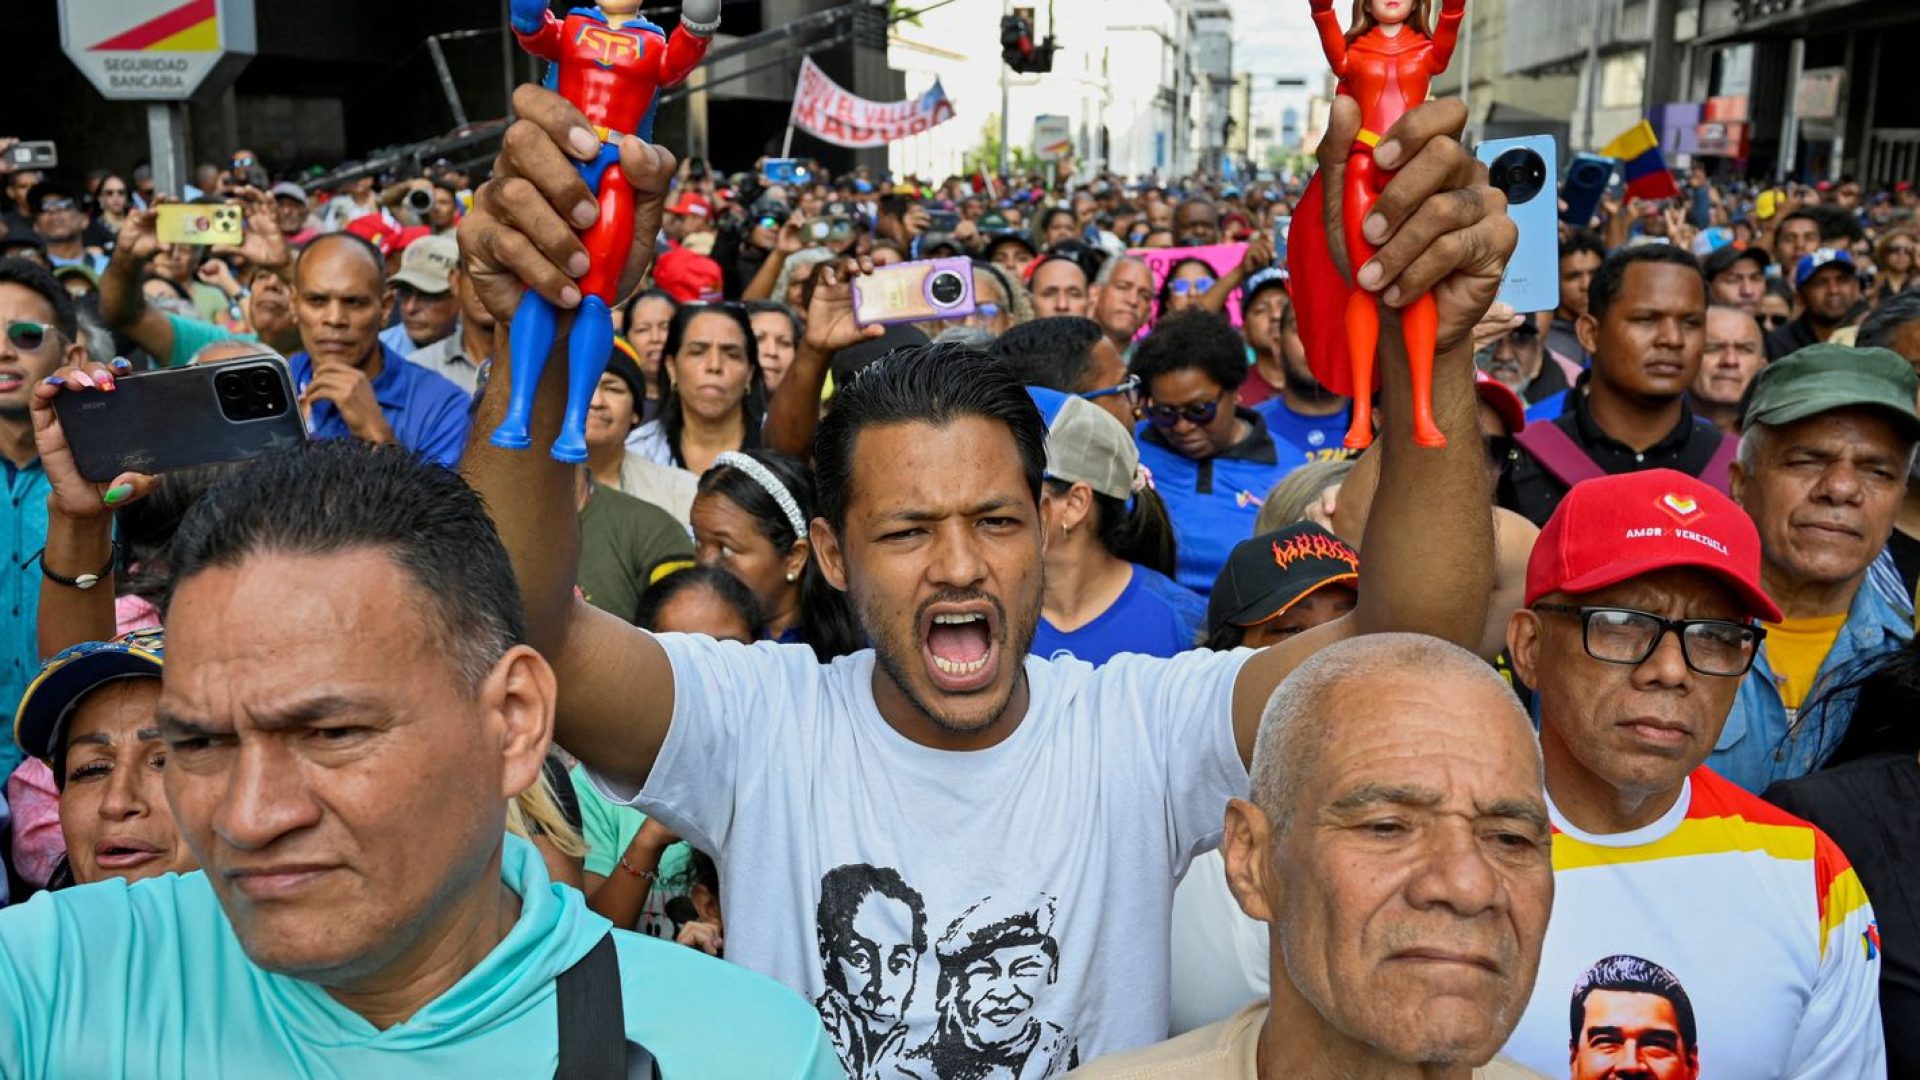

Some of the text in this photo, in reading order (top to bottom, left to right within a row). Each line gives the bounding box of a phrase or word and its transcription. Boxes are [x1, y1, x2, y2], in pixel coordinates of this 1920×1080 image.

[104, 58, 188, 72] SEGURIDAD
[110, 74, 184, 88] BANCARIA
[797, 96, 957, 142] MADURO
[1626, 527, 1663, 539] AMOR
[1675, 528, 1730, 556] VENEZUELA
